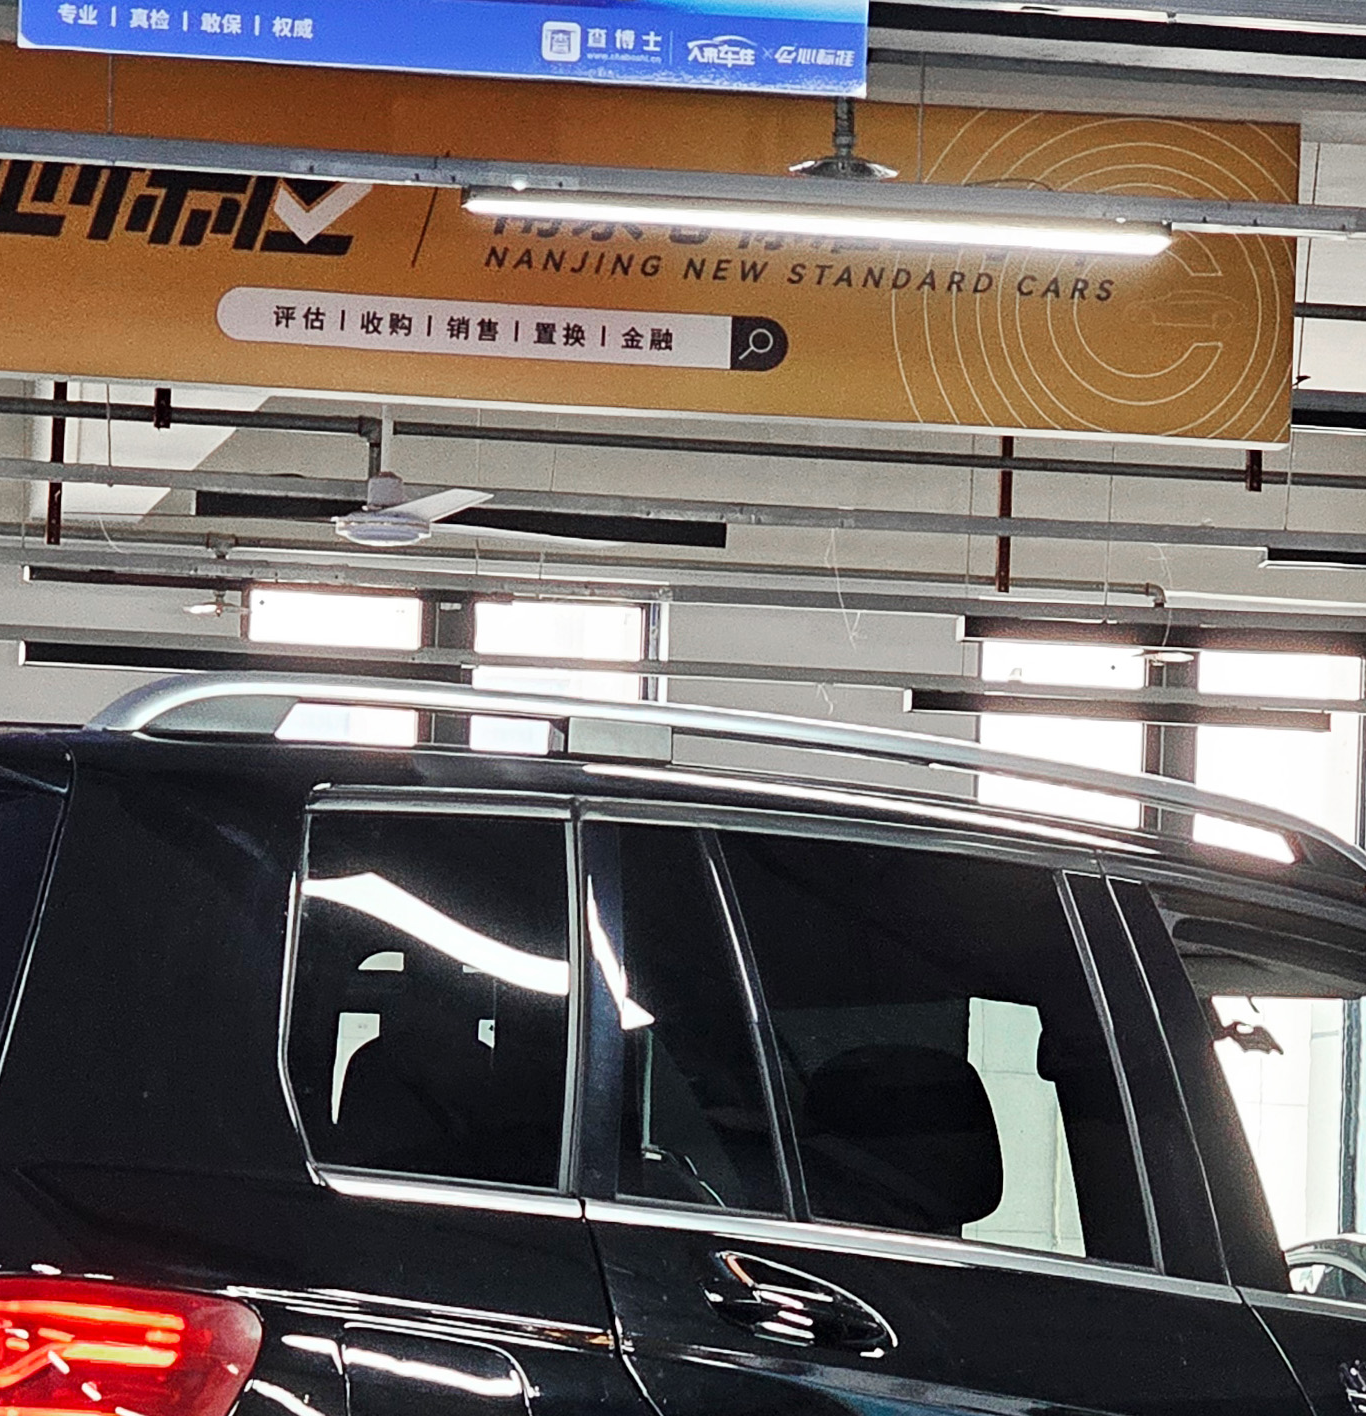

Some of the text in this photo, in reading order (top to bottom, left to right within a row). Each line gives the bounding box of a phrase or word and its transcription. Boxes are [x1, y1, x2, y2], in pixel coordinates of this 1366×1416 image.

[57, 3, 314, 39] 专业 真检 敢保 权威
[587, 27, 663, 52] 查博士
[484, 245, 1115, 302] NANJING NEW STANDARD CARS
[273, 304, 674, 352] 评估 收购 销售 置换 金融
